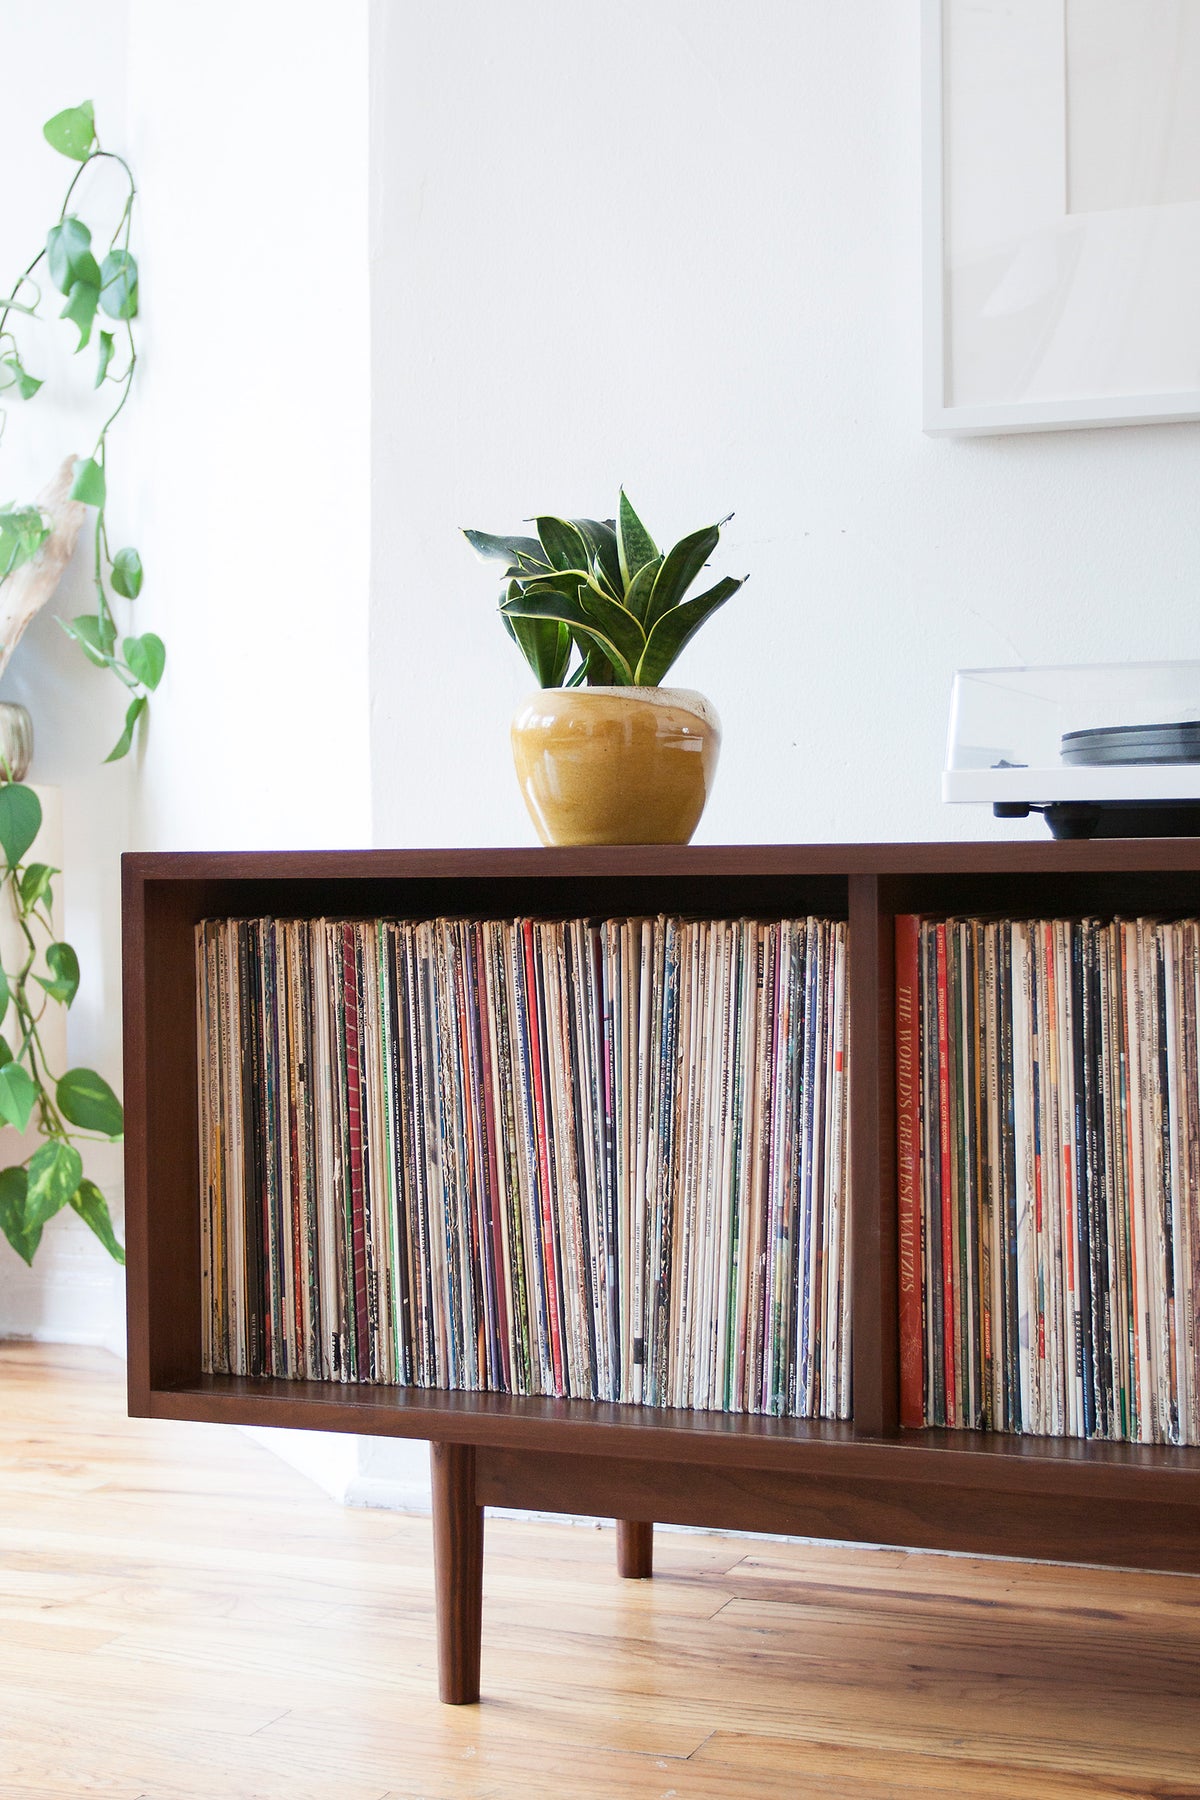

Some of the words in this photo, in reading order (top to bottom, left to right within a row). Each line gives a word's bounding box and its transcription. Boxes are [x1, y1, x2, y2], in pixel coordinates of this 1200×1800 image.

[898, 986, 911, 1024] THE
[899, 1029, 912, 1108] WORLD'S
[900, 1114, 913, 1208] GREATEST
[900, 1212, 914, 1292] WALTZES
